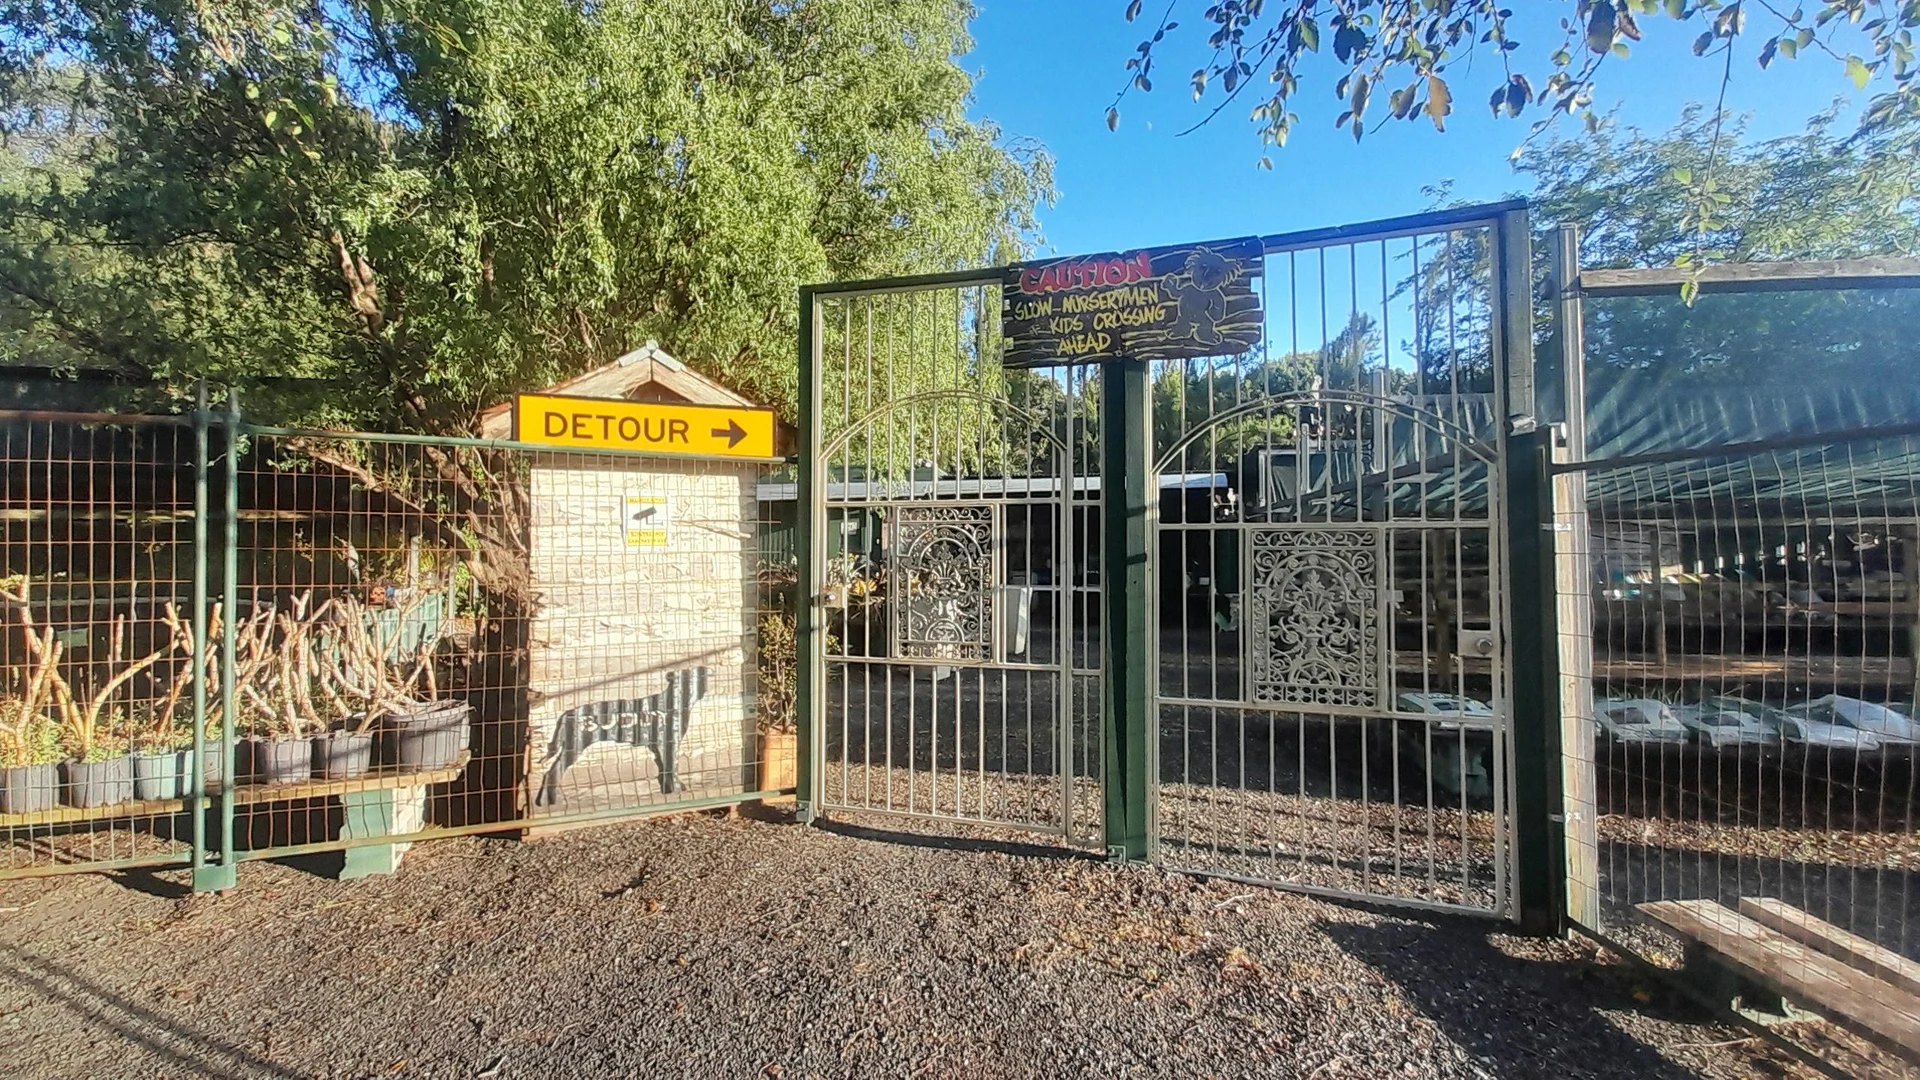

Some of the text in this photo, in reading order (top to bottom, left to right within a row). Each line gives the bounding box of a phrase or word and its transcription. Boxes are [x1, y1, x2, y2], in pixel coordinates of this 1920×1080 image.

[1019, 251, 1152, 295] CAUTION
[1014, 282, 1159, 320] SLOW NURSERYMEN
[1049, 304, 1167, 335] KIDS CROSSING
[1056, 332, 1111, 356] AHEAD
[544, 411, 689, 444] DETOUR
